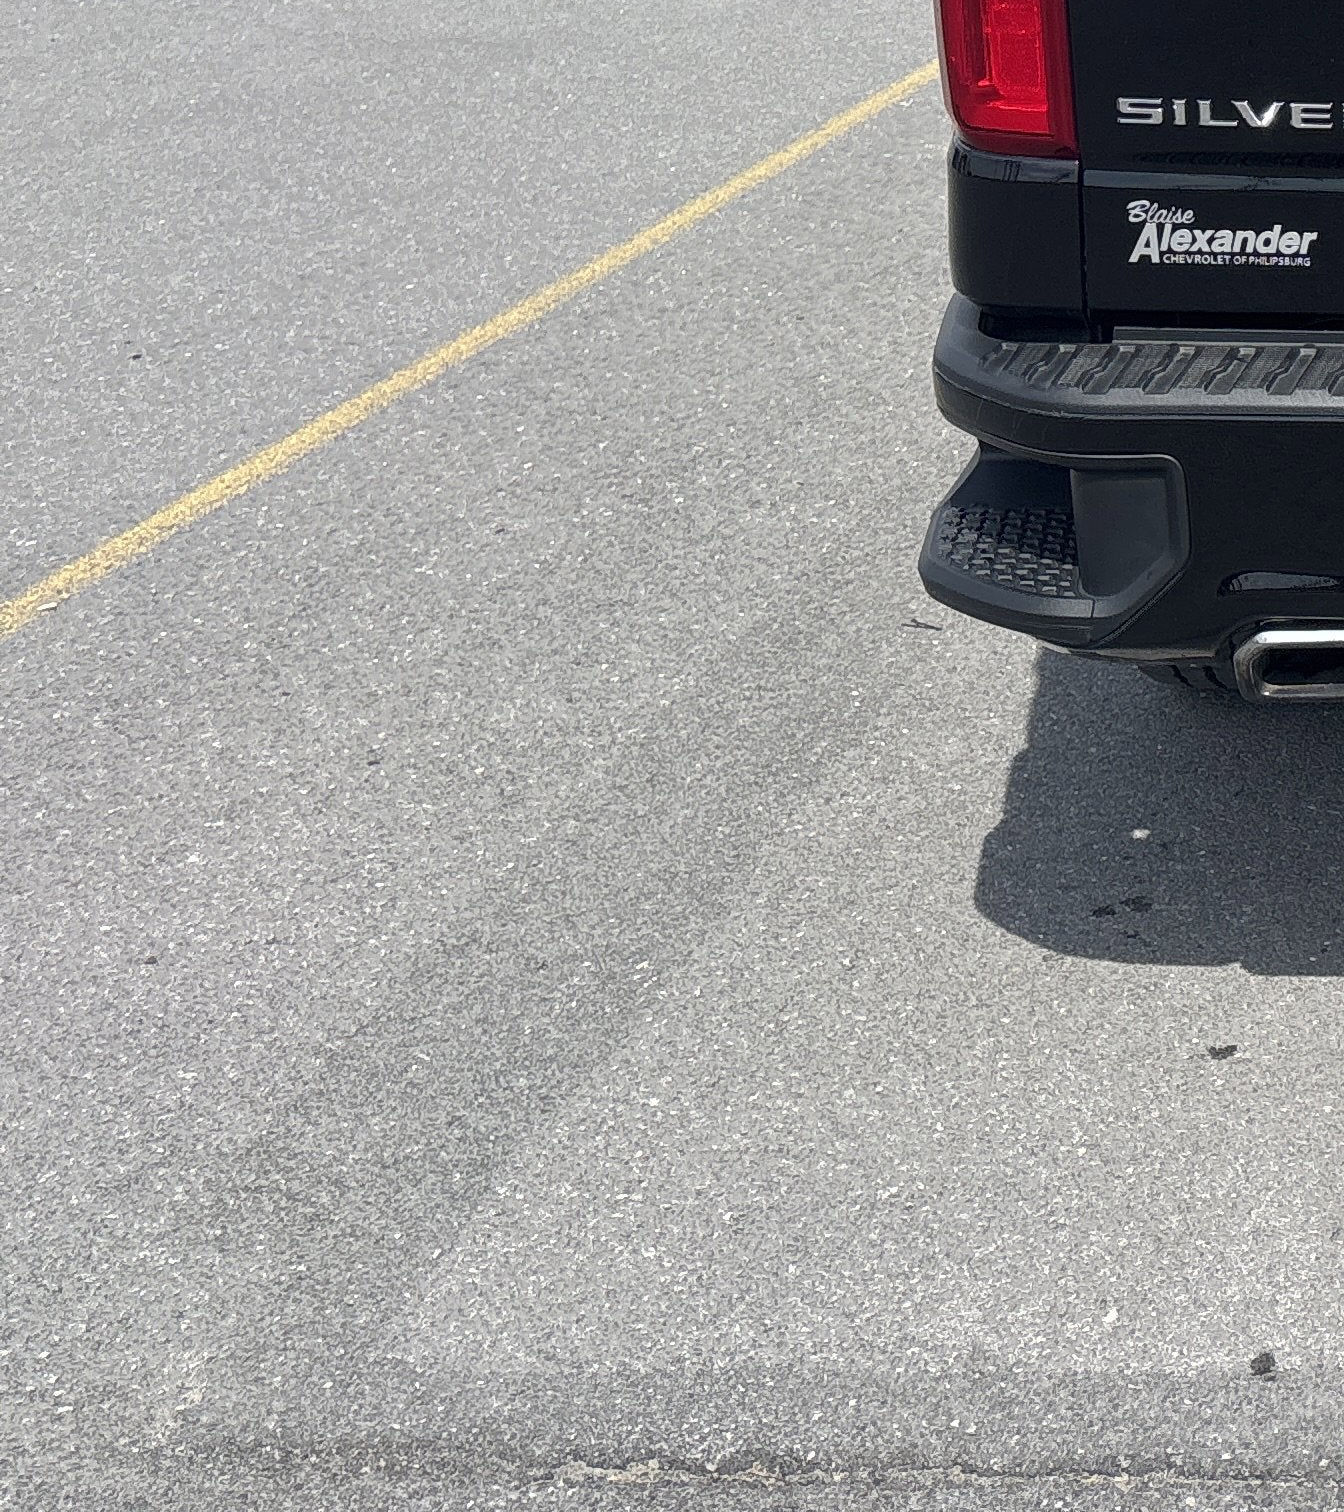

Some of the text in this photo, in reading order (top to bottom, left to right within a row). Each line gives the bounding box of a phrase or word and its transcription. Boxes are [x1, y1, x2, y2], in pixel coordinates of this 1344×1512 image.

[1126, 199, 1196, 225] Blaise
[1128, 222, 1319, 264] Alexander
[1162, 254, 1312, 267] CHEVROLET OF PHILIPSBURG
